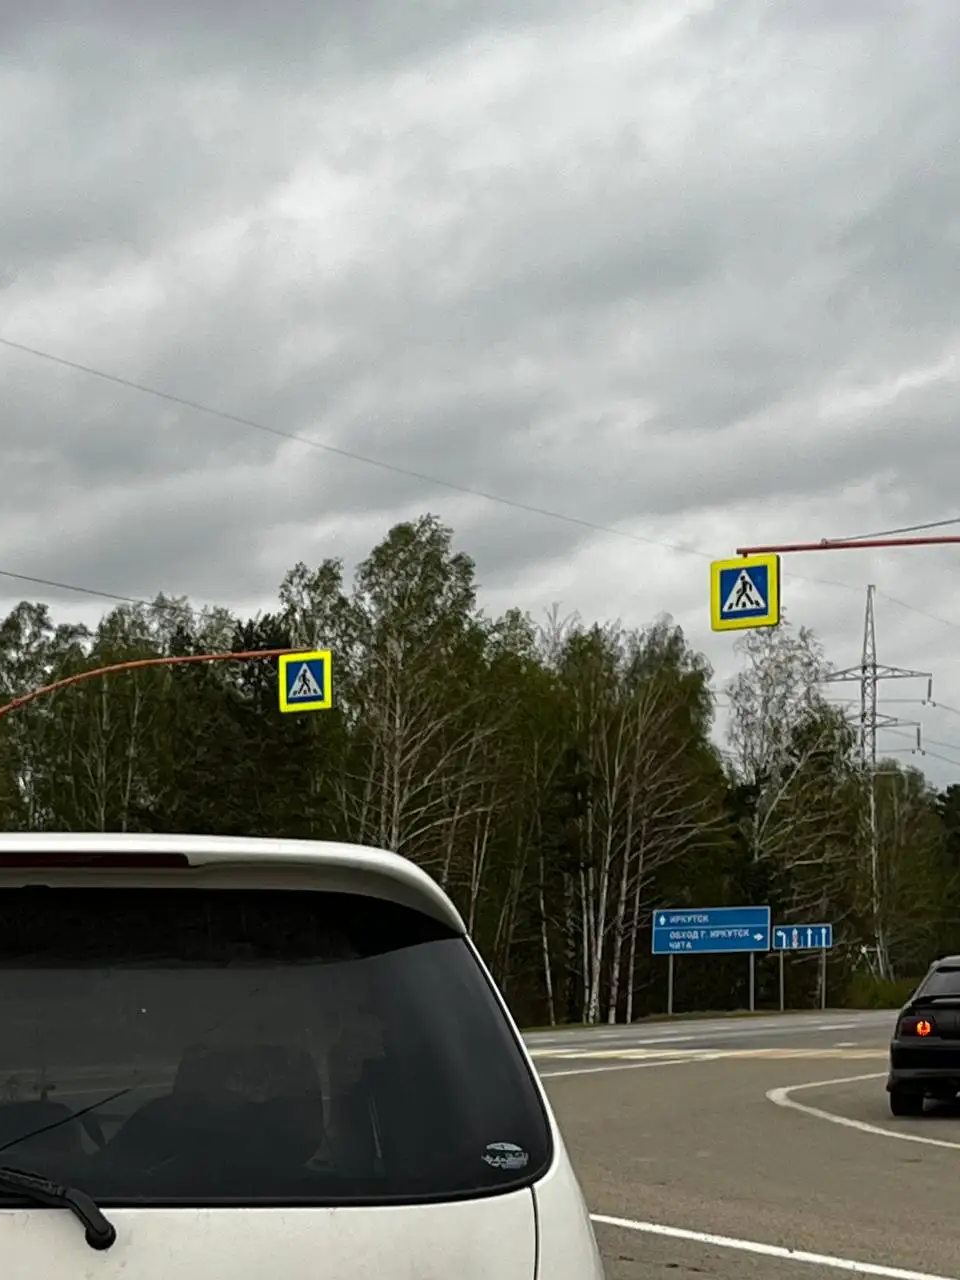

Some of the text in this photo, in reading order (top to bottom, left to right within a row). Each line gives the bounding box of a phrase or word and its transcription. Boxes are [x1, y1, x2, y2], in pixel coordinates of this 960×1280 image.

[669, 914, 709, 924] ИРКУТСК
[669, 930, 699, 940] ОБХОД
[710, 929, 749, 938] ИРКУТСК
[669, 941, 692, 950] ЧИТА
